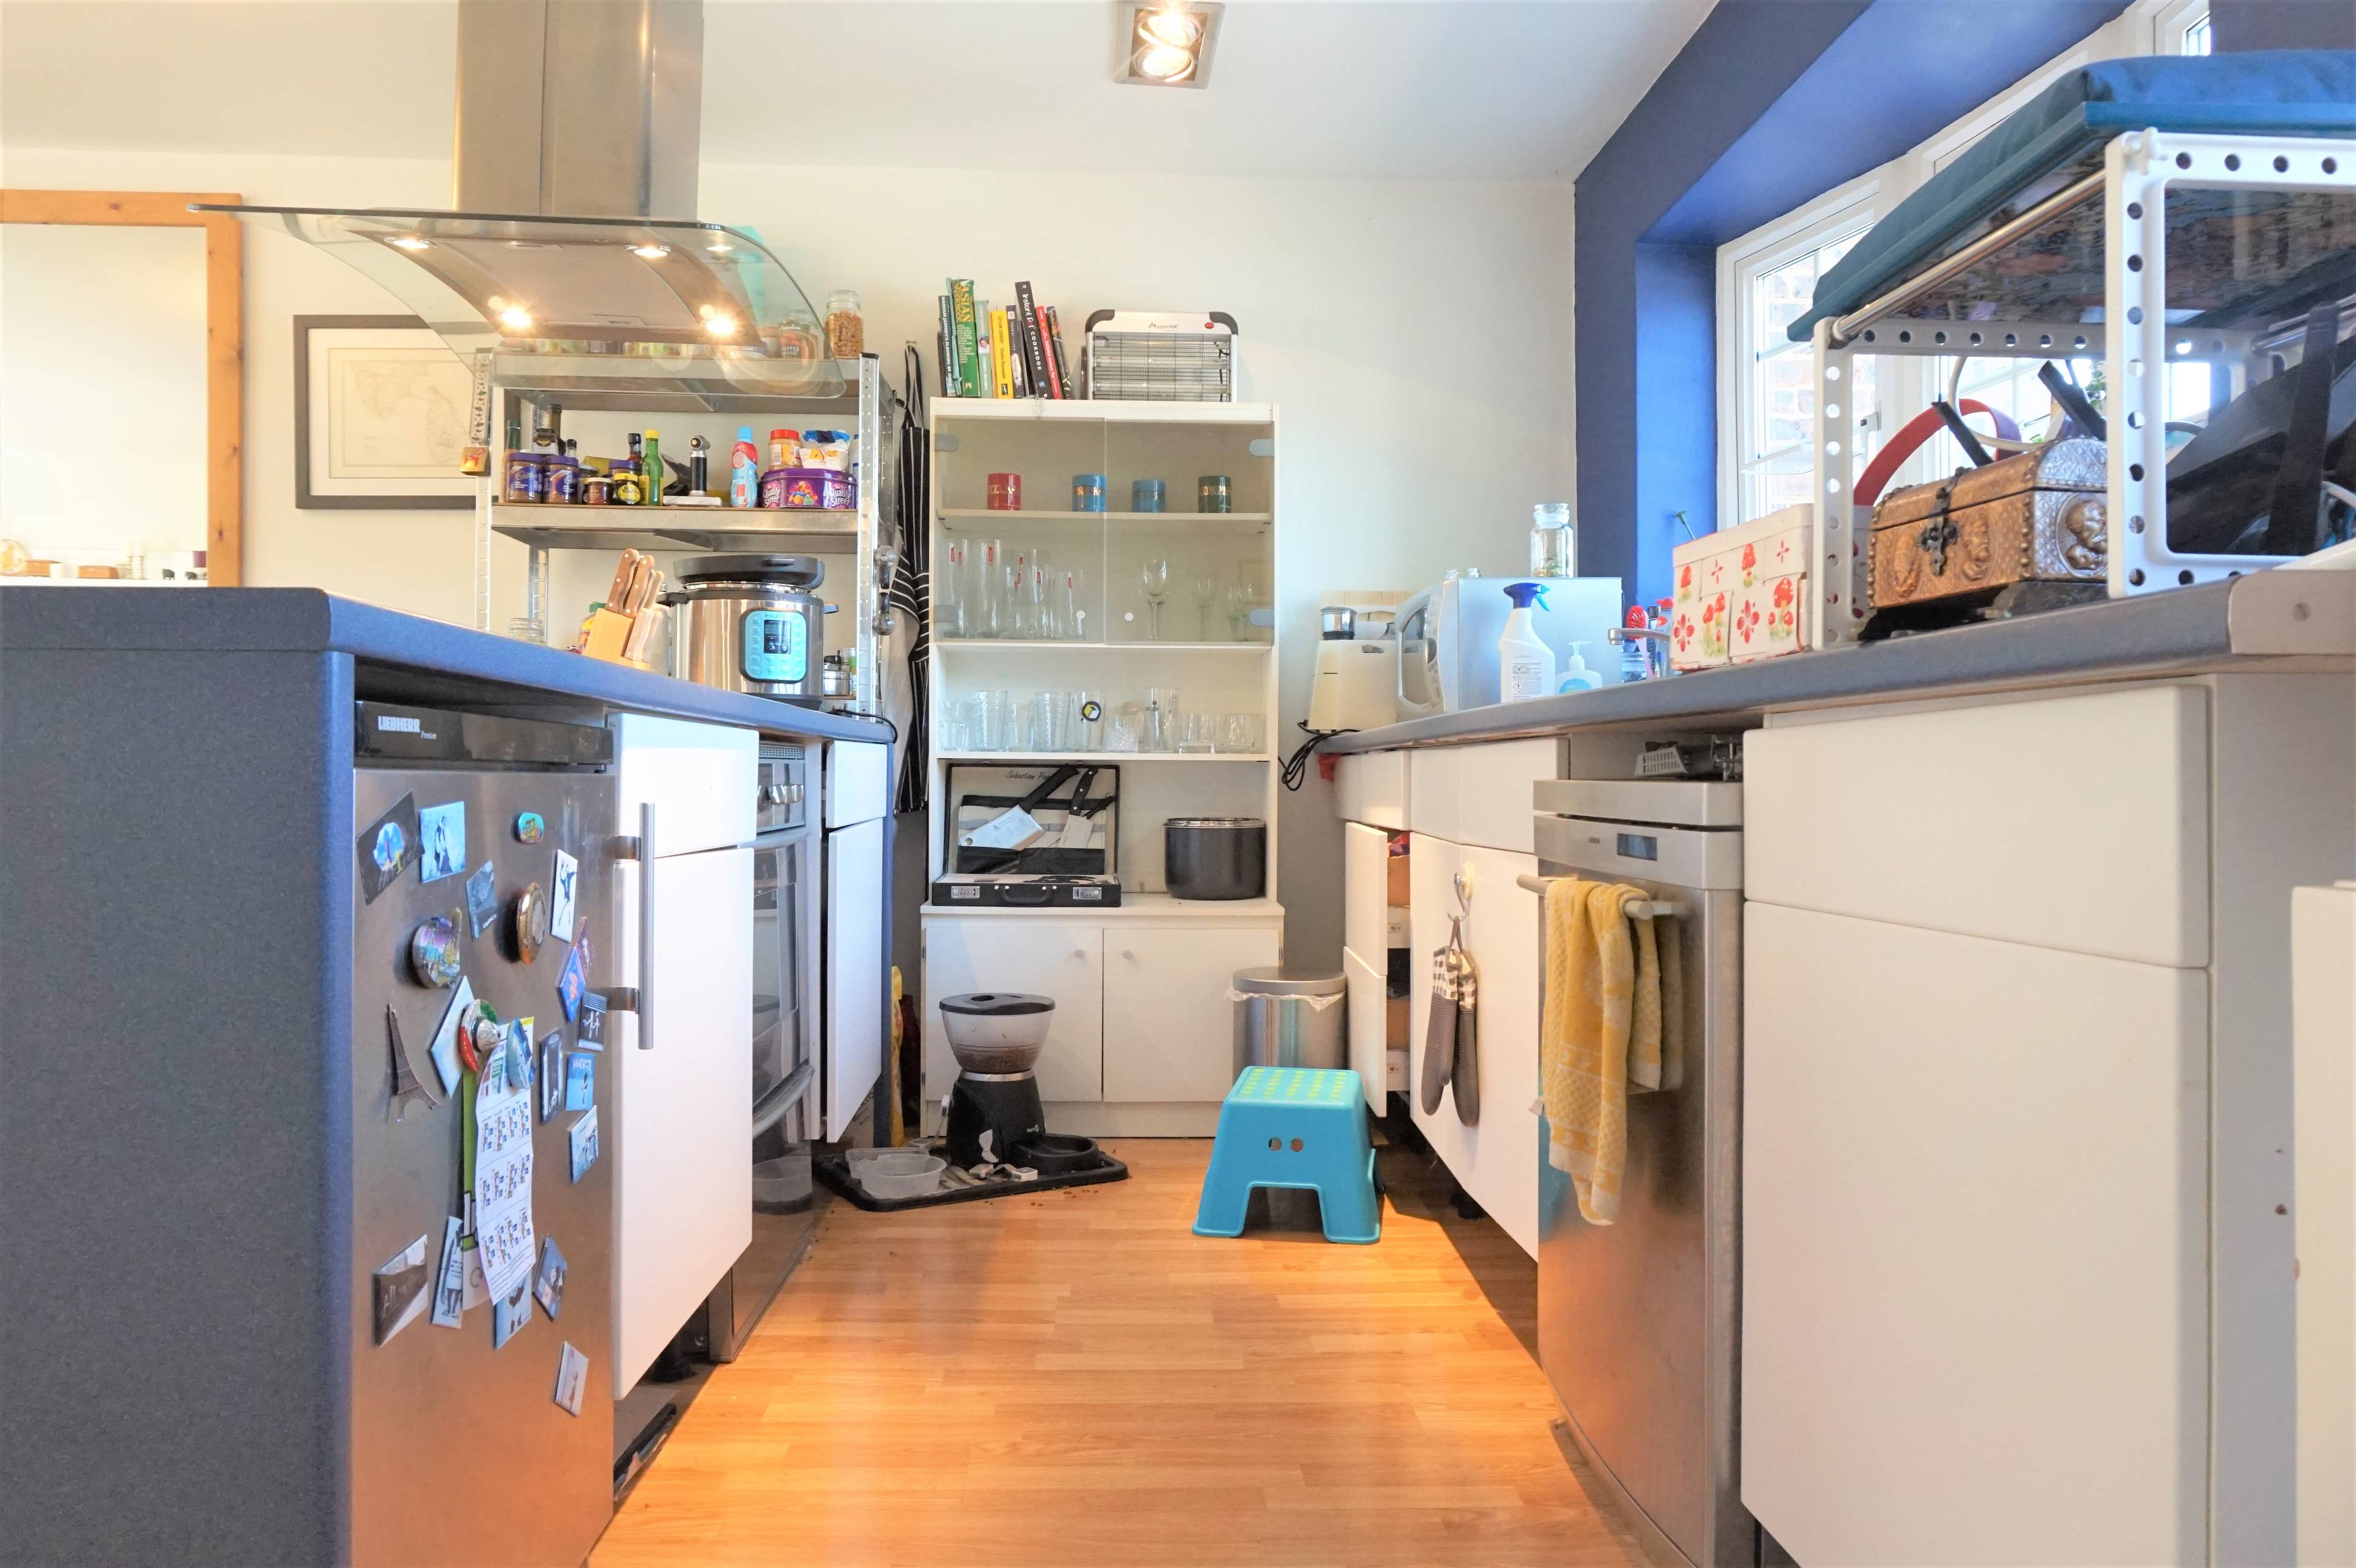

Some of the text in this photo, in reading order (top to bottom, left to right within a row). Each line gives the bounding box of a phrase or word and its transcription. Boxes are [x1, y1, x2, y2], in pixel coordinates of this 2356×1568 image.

[1022, 294, 1032, 316] Instant
[1031, 331, 1042, 371] COOKBOOK
[763, 486, 781, 498] Quality
[829, 490, 851, 499] Quality
[831, 498, 850, 507] Street
[378, 715, 420, 732] LIEBHERR
[1007, 770, 1035, 779] Sebastian
